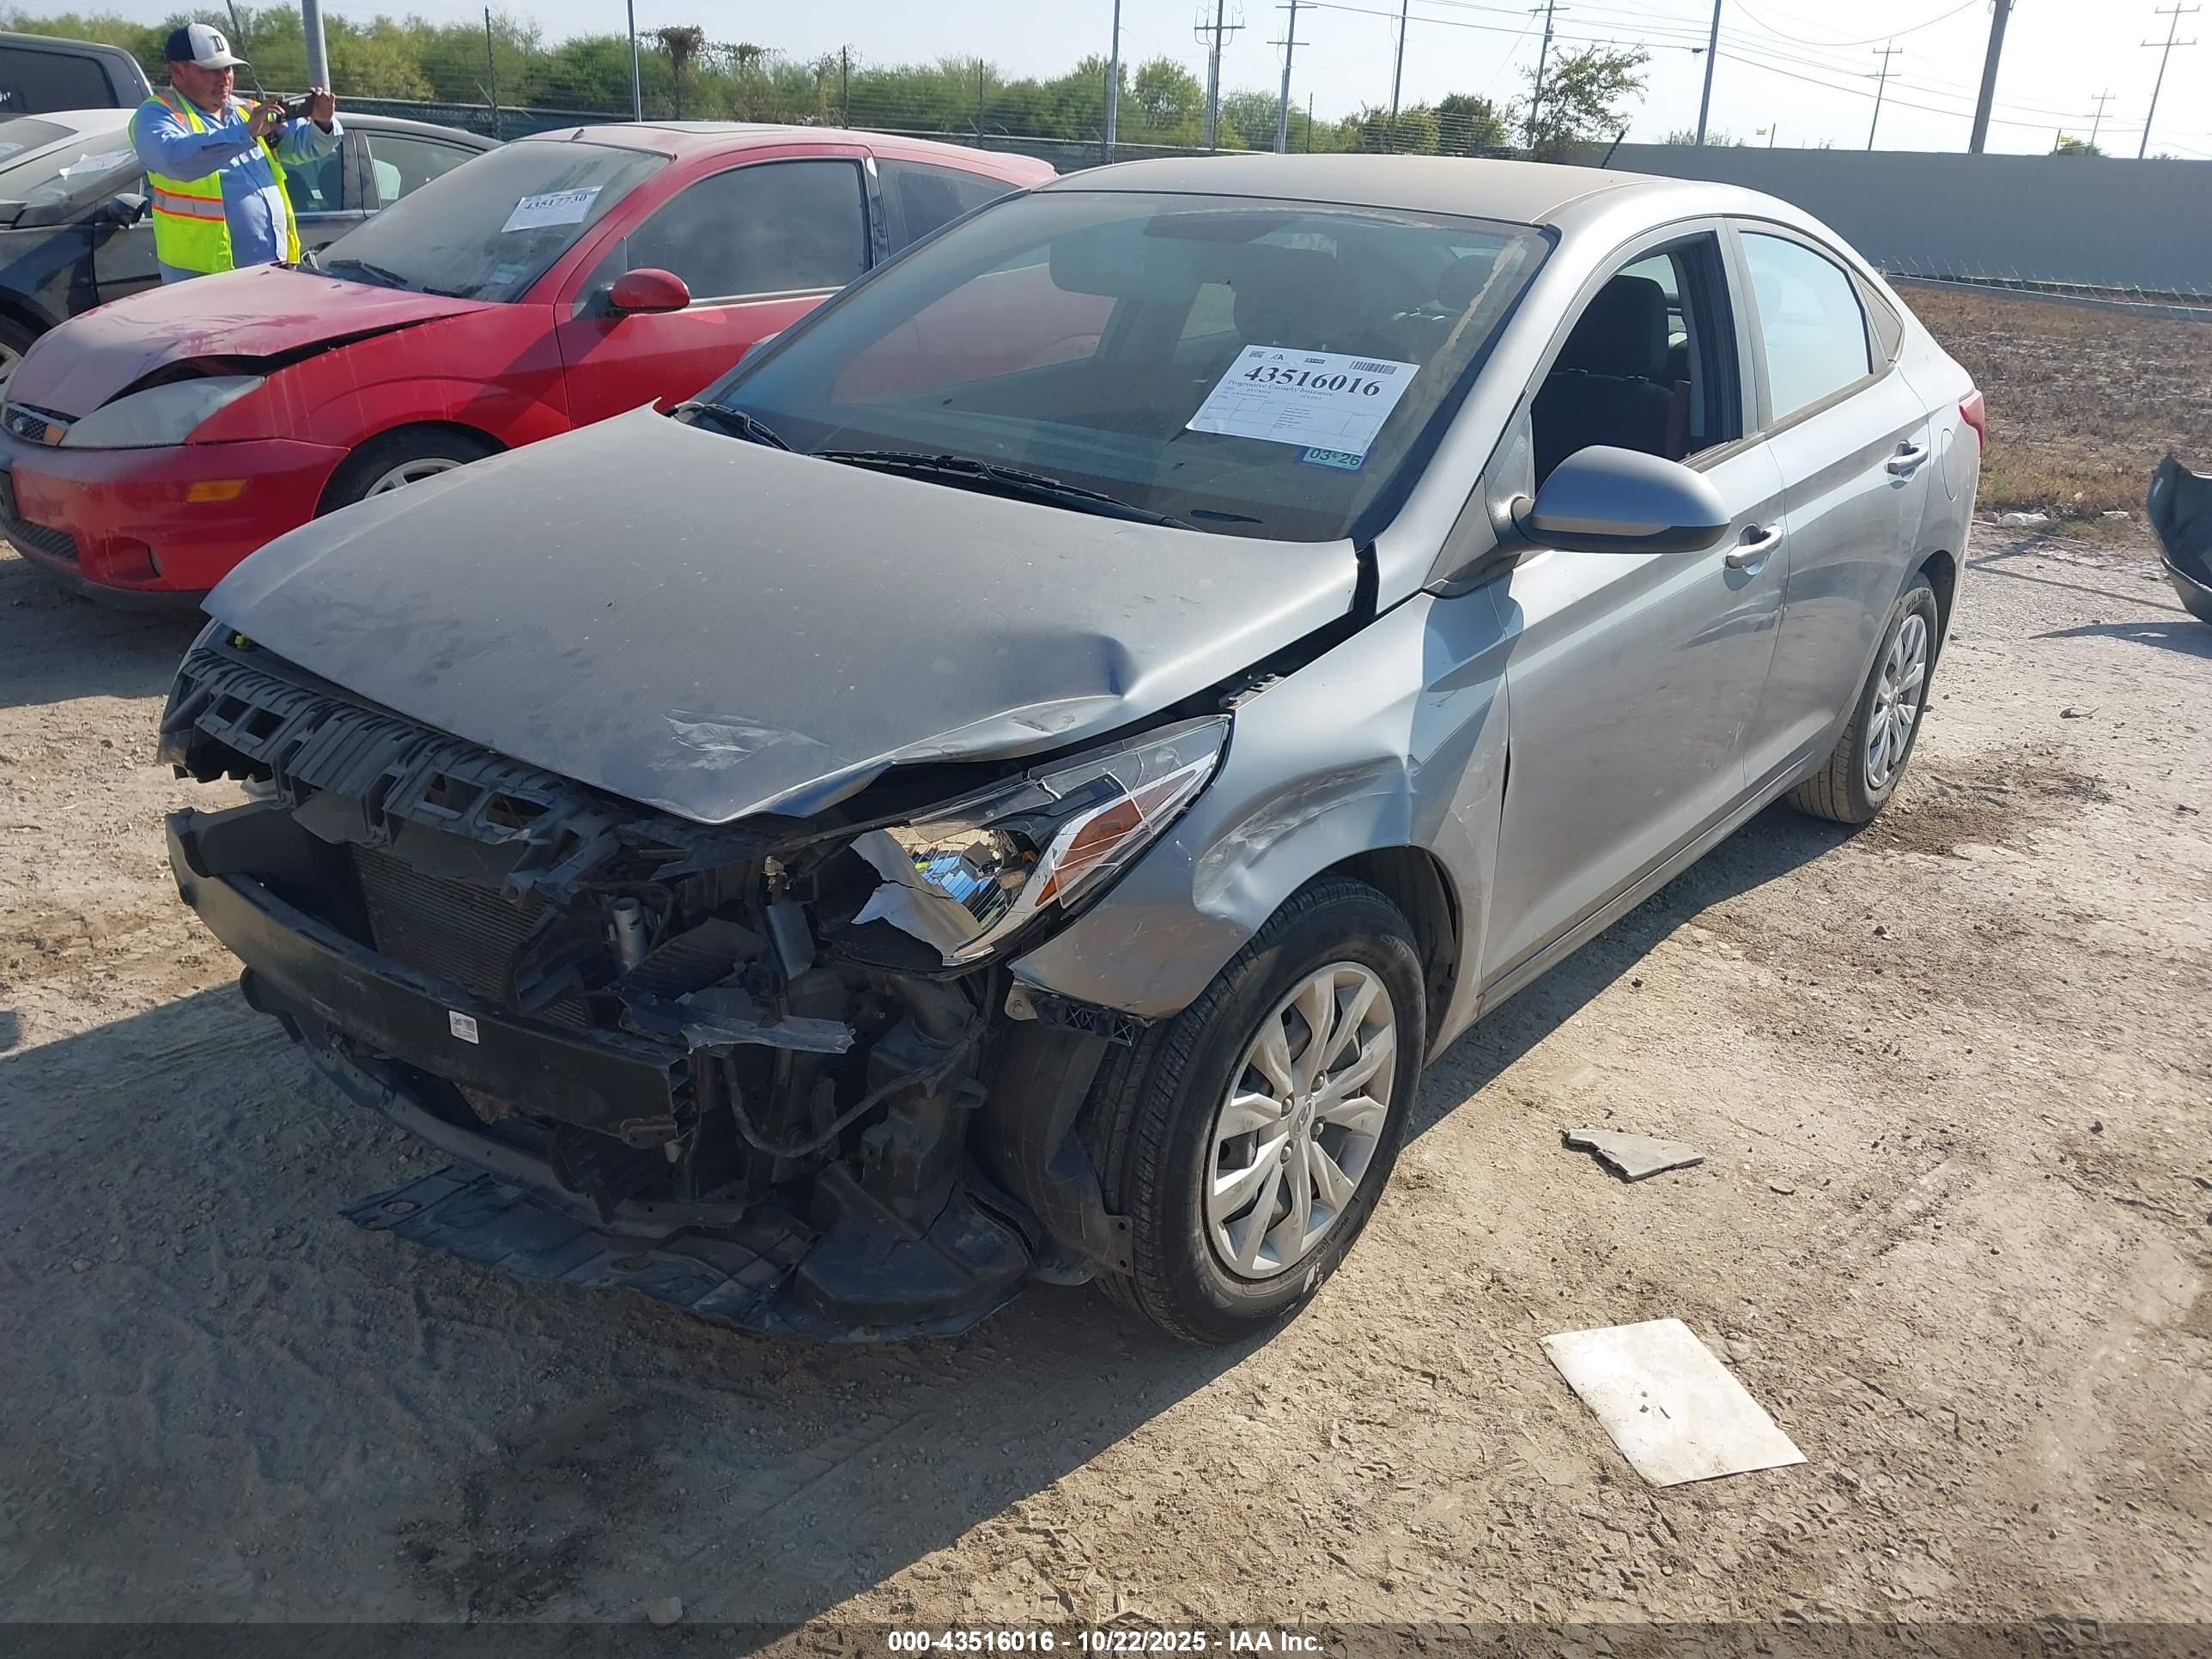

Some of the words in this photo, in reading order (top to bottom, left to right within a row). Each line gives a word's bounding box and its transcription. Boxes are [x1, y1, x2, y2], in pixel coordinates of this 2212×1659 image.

[1243, 364, 1387, 397] 43516016
[1268, 383, 1299, 393] Casualty
[1299, 386, 1334, 398] Insurance
